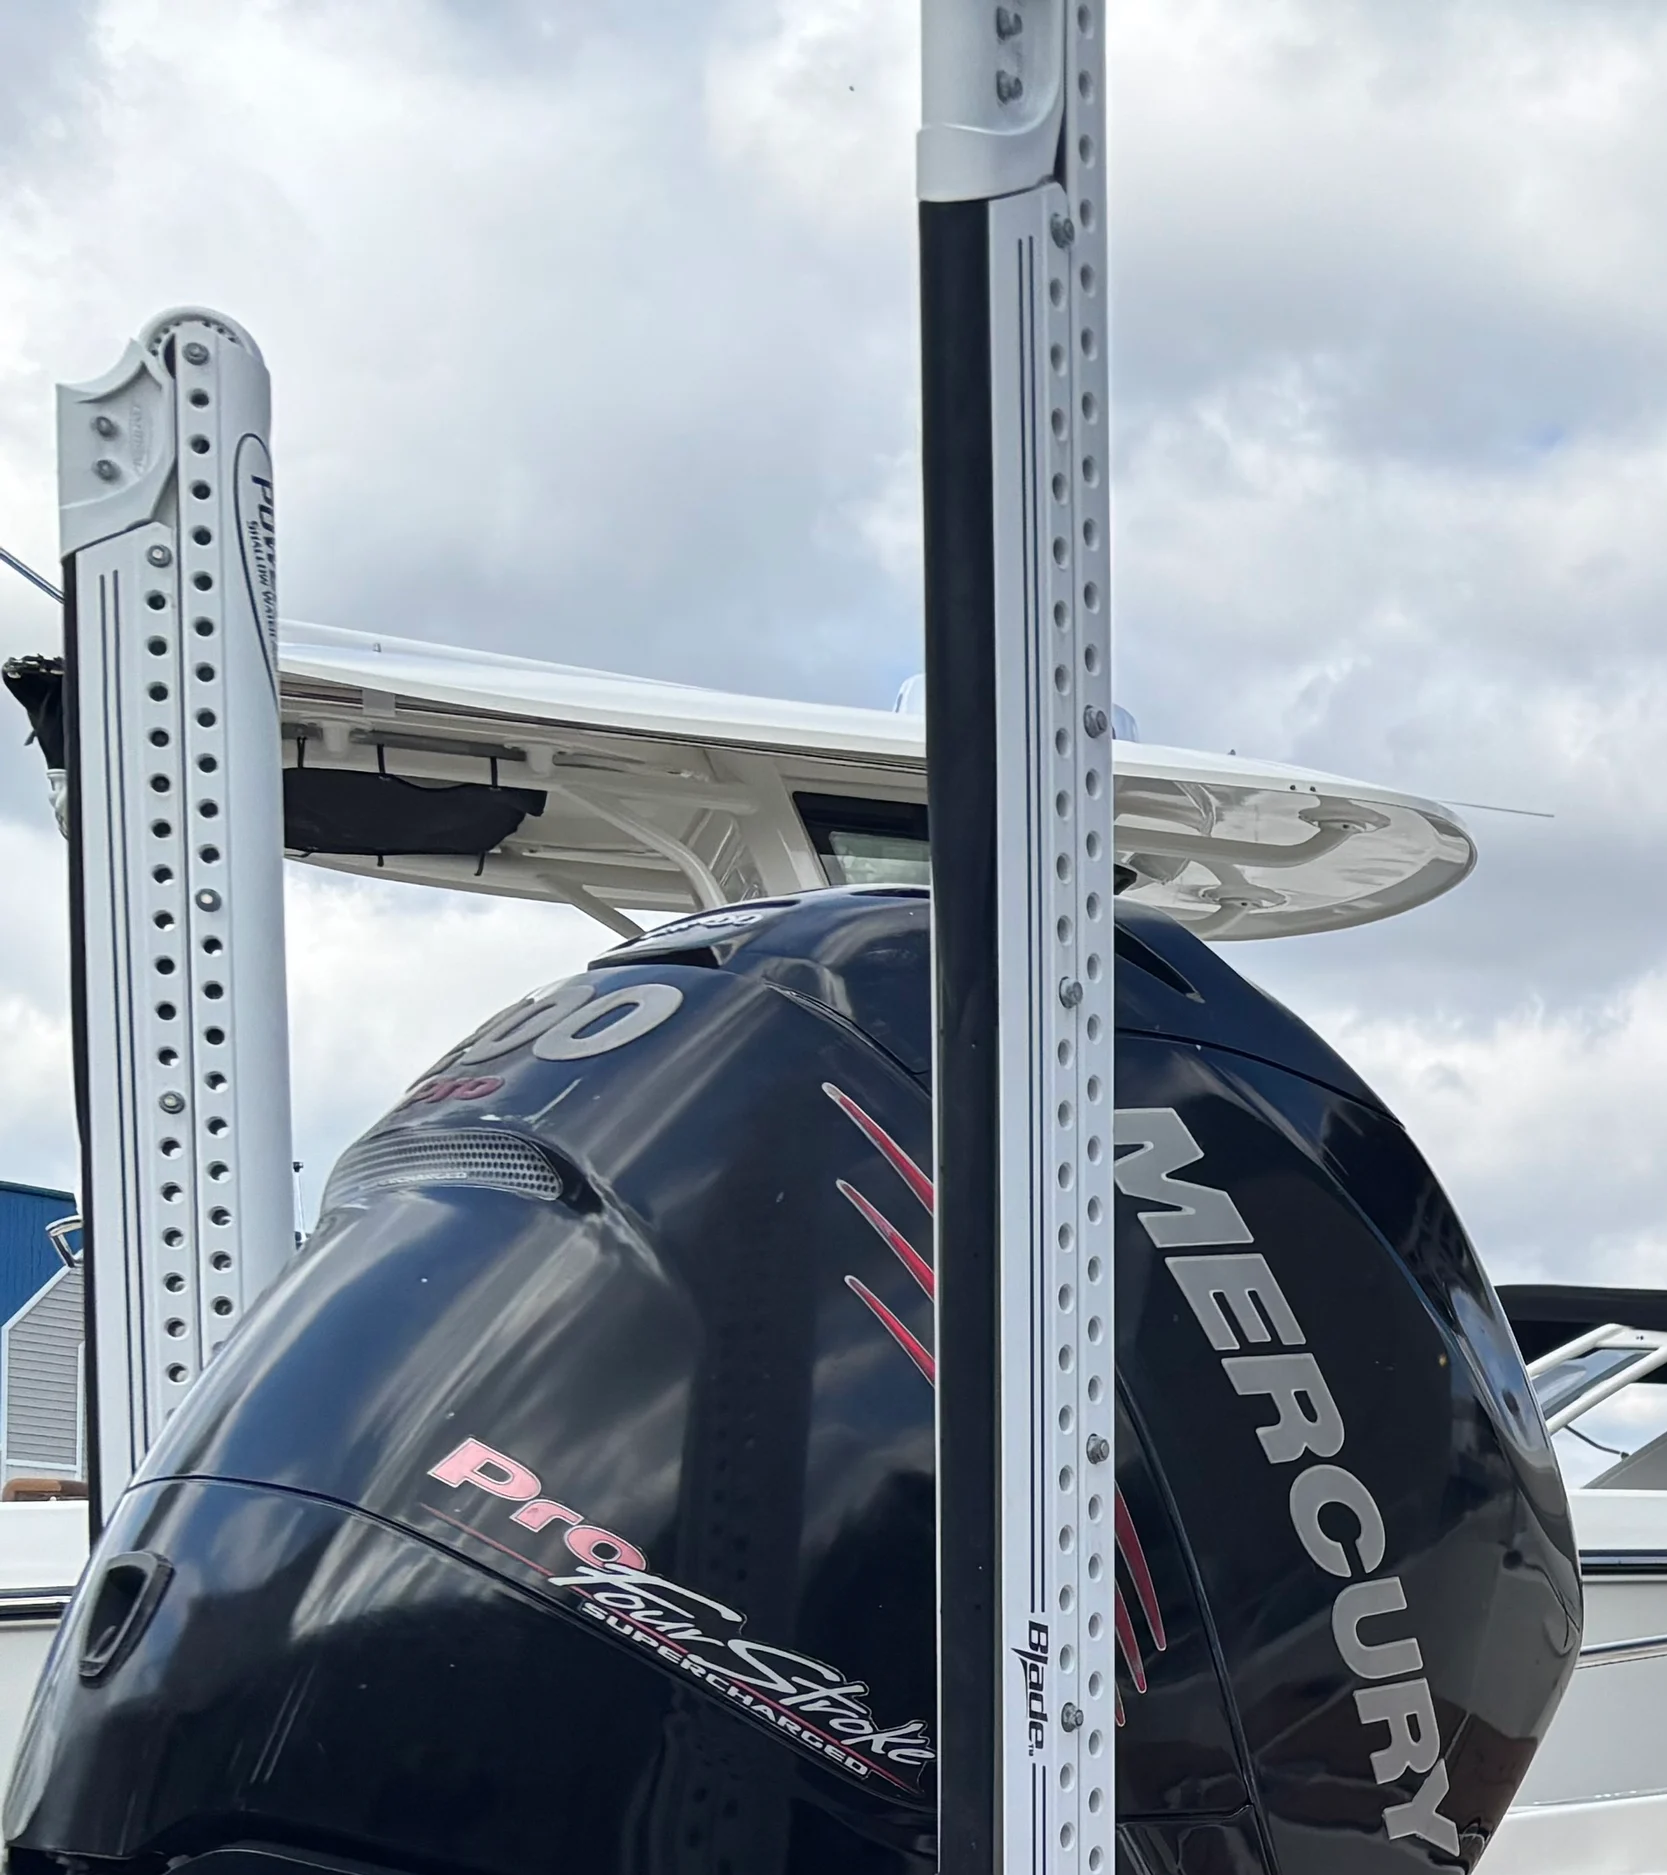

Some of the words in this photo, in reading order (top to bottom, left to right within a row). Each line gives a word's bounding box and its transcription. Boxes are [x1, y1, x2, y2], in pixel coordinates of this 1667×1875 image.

[426, 1435, 650, 1571] Pro
[1112, 1106, 1462, 1857] MERCURY
[580, 1599, 872, 1779] SUPERCHARGED
[1012, 1620, 1048, 1754] Blade
